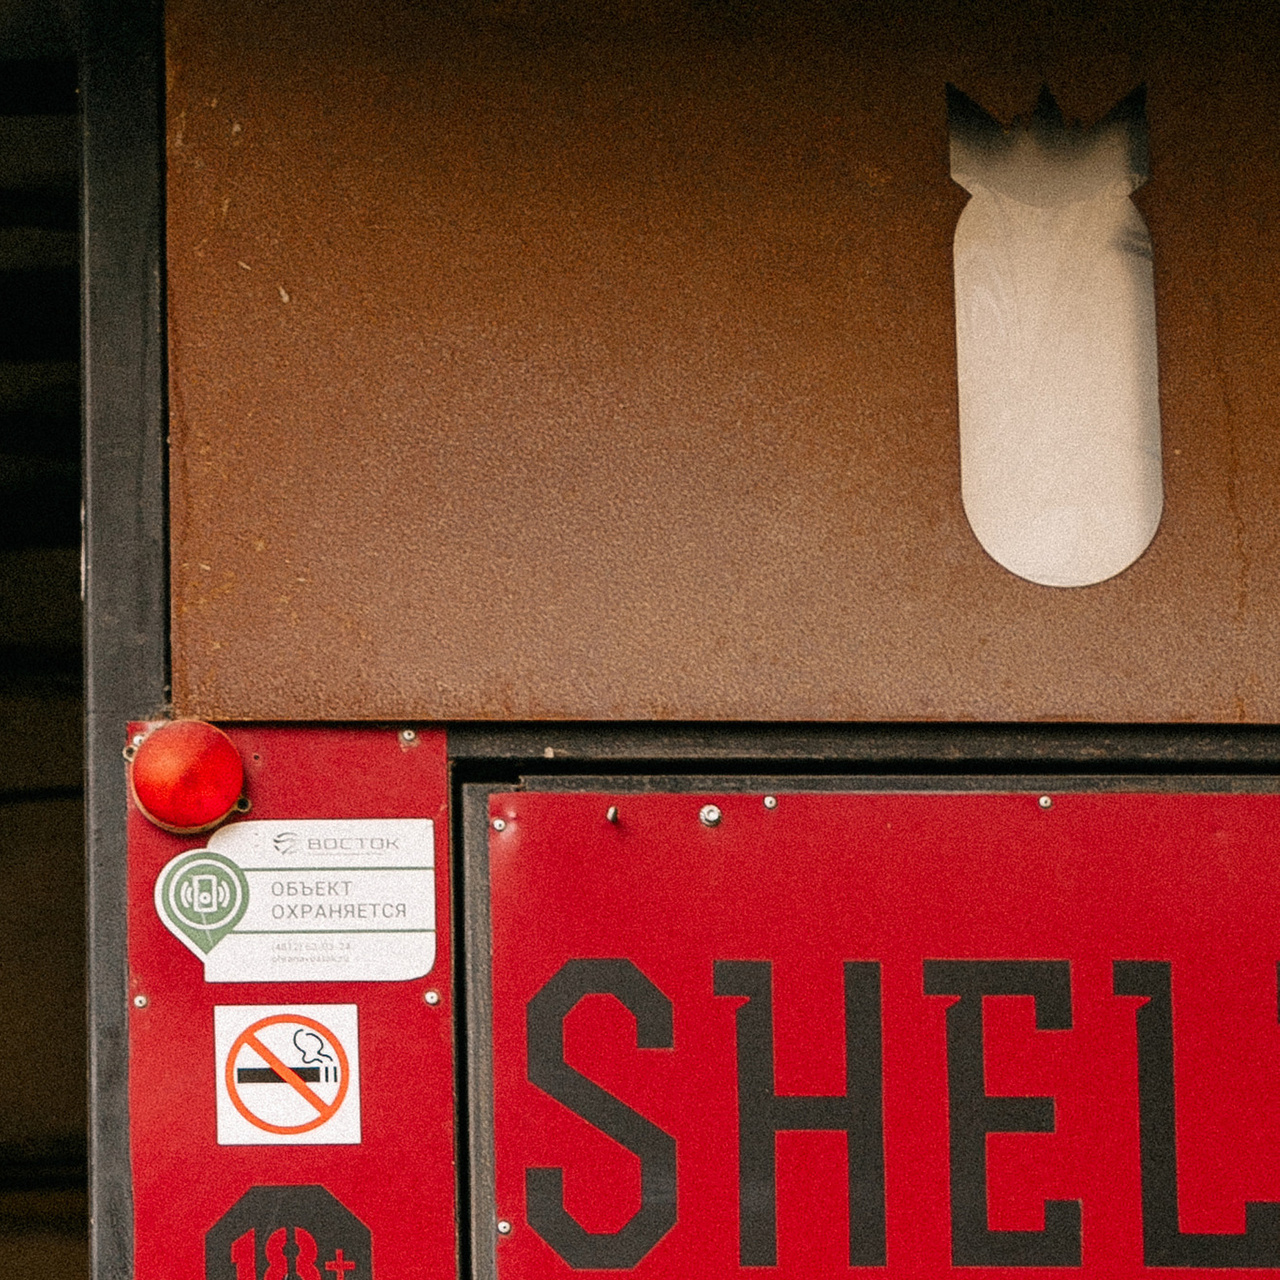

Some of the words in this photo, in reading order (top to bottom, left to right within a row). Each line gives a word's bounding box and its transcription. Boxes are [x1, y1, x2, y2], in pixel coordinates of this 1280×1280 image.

[307, 837, 400, 850] ВОСТОК
[271, 881, 353, 897] ОБЪЕКТ
[271, 903, 407, 920] ОХРАНЯЕТСЯ
[525, 957, 1280, 1271] SHEL
